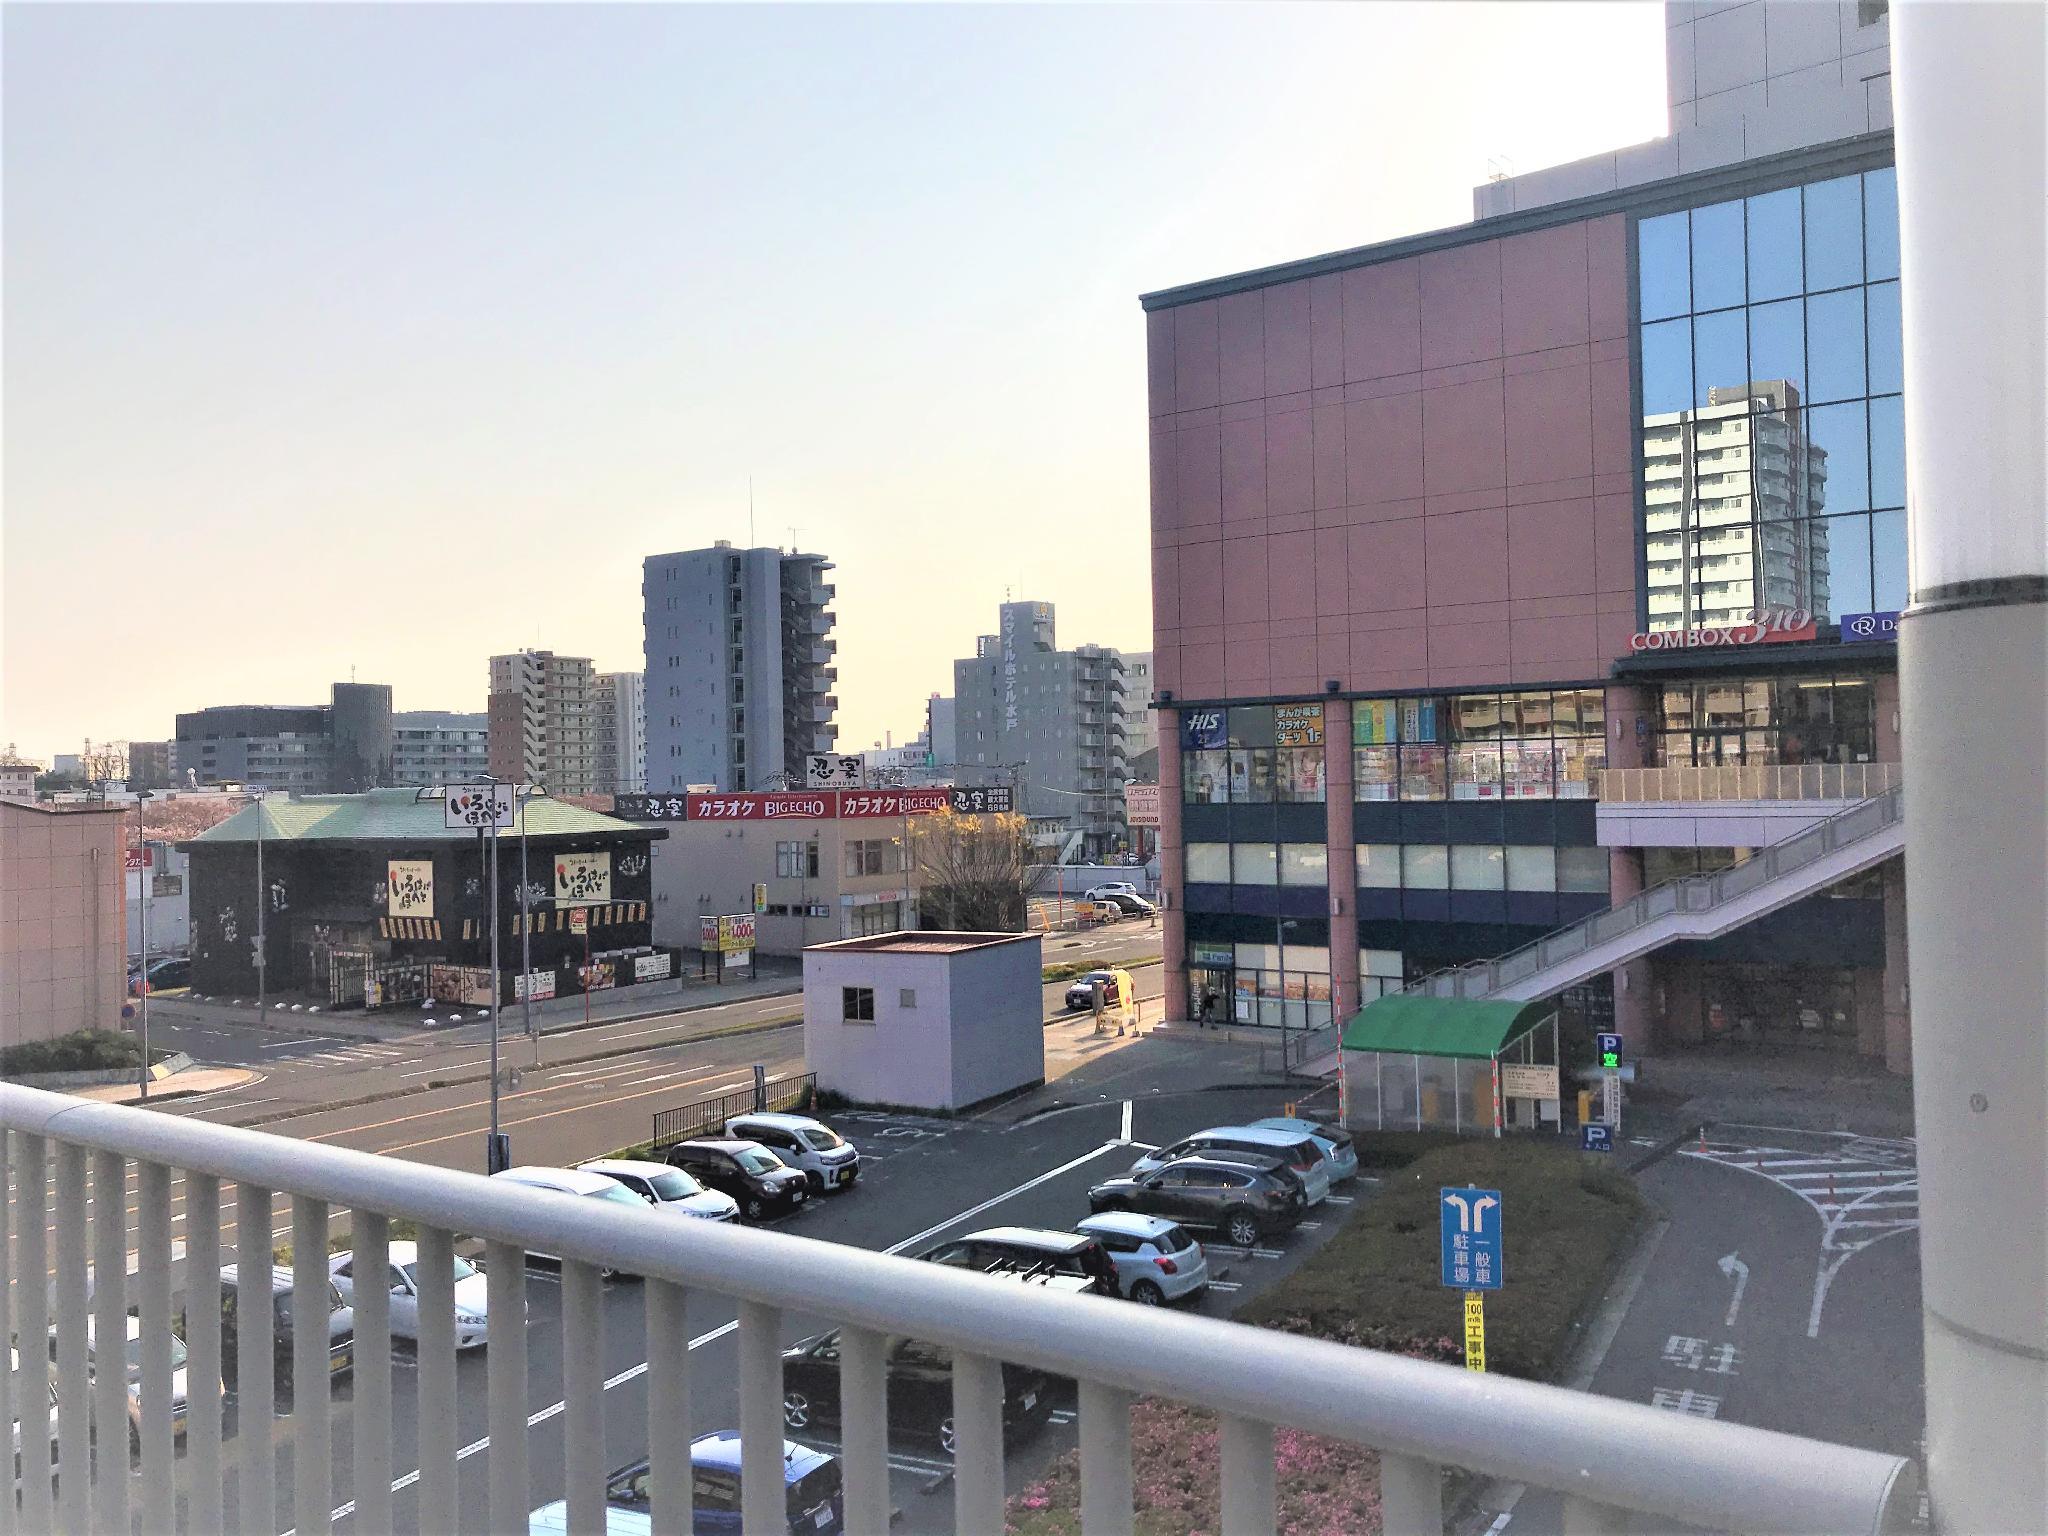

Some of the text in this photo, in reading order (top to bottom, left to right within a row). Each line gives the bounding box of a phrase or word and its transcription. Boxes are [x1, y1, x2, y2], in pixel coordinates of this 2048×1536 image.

[1630, 608, 1811, 650] COMBOX 310
[1277, 719, 1308, 730] カラオケ
[1277, 731, 1301, 744] ダーツ
[1306, 727, 1321, 743] 1F
[698, 800, 755, 817] カラオケ
[844, 797, 897, 815] カラオケ
[1603, 1036, 1617, 1050] P
[1587, 1127, 1606, 1142] P
[1453, 1234, 1470, 1283] 駐車場
[1475, 1239, 1491, 1284] 一般車
[1466, 1303, 1482, 1315] 100
[1467, 1325, 1482, 1371] 工事中
